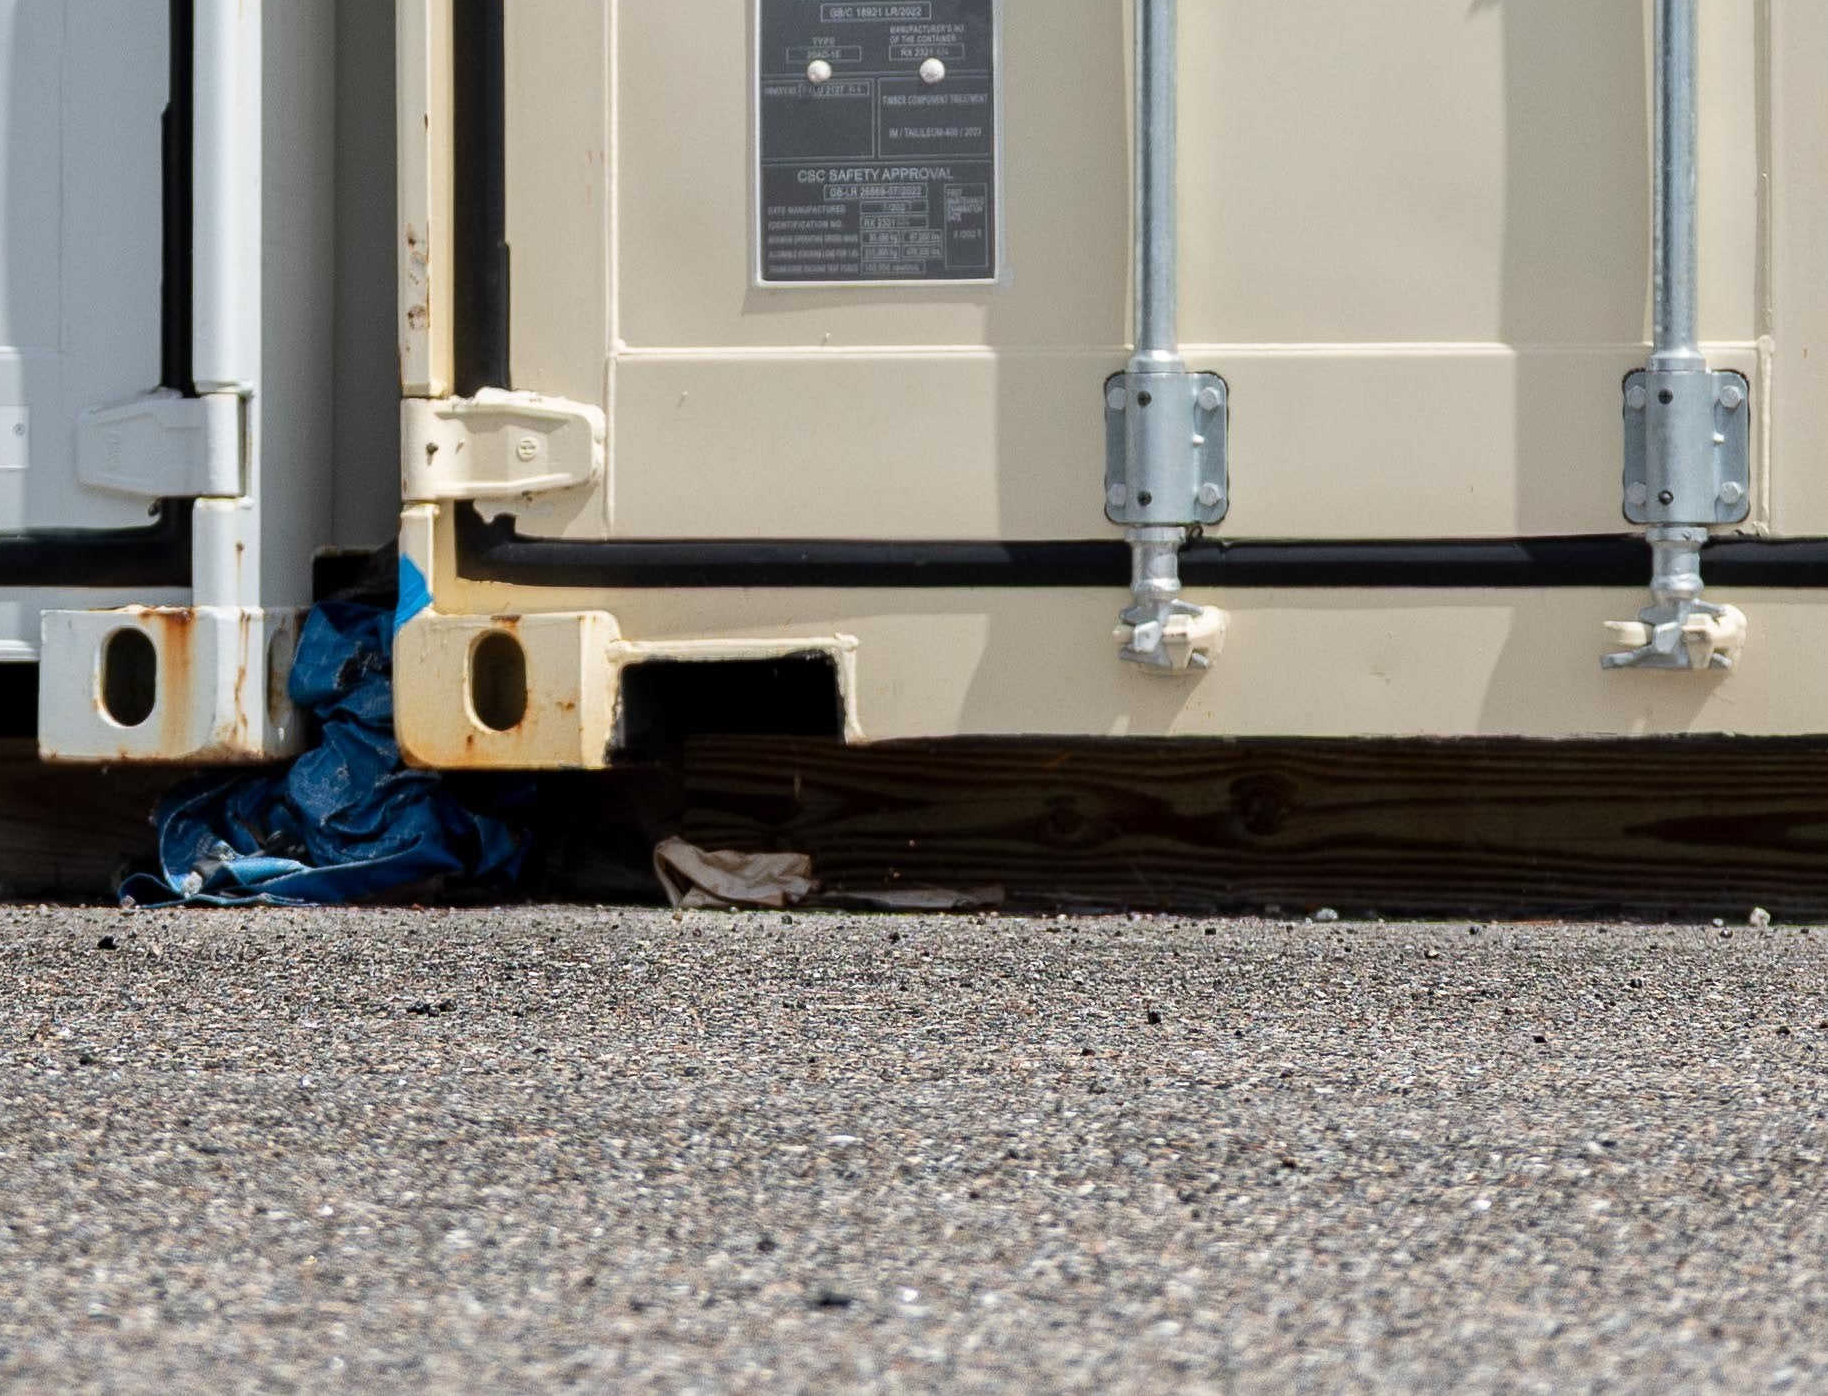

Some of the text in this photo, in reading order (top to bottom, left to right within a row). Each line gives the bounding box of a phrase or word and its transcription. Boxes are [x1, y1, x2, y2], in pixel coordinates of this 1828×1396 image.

[797, 167, 953, 183] CSC SAFETY APPROVAL
